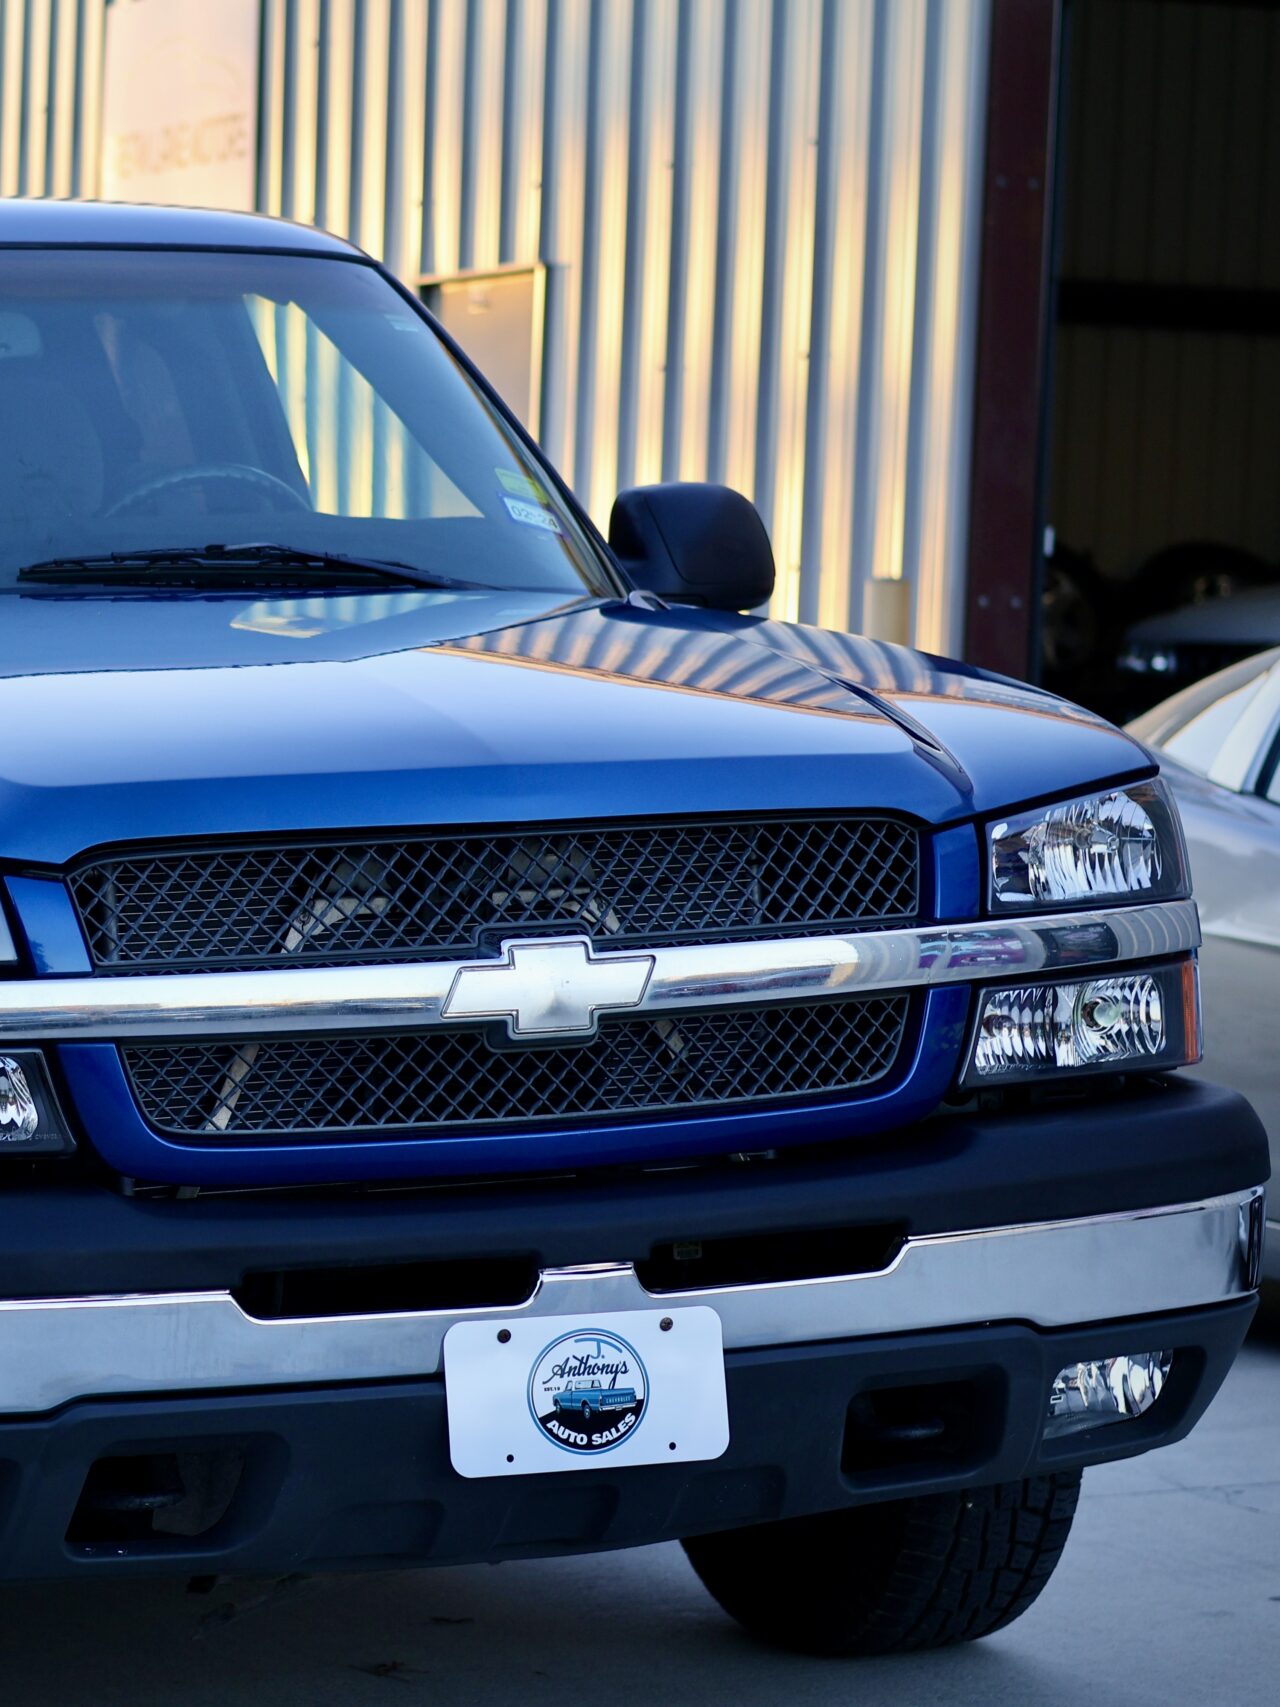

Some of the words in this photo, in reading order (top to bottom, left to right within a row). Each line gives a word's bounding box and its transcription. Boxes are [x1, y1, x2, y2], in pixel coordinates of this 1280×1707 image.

[574, 1338, 623, 1360] J.
[542, 1354, 630, 1390] Anthony's
[546, 1420, 588, 1445] AUTO
[591, 1412, 636, 1445] SALES
